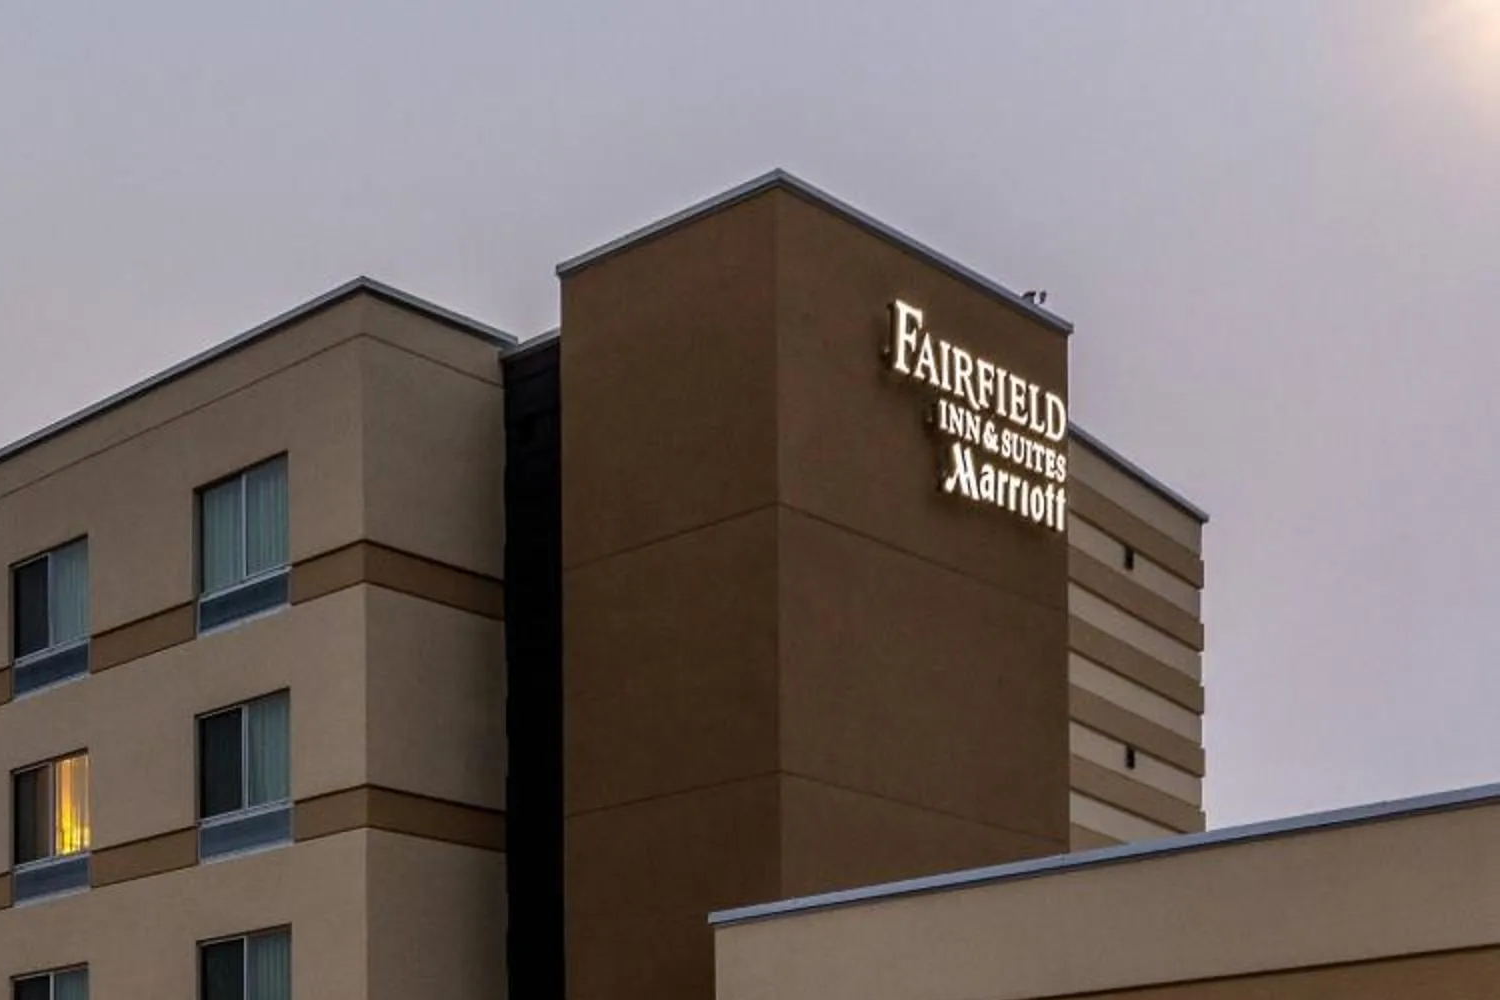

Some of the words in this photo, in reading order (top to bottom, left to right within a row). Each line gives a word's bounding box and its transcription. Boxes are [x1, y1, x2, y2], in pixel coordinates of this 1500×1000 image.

[893, 299, 1067, 442] FAIRFIELD
[938, 399, 982, 445] INN
[982, 419, 1000, 454] &
[1001, 427, 1067, 483] SUITES
[944, 442, 1066, 532] Marriott
